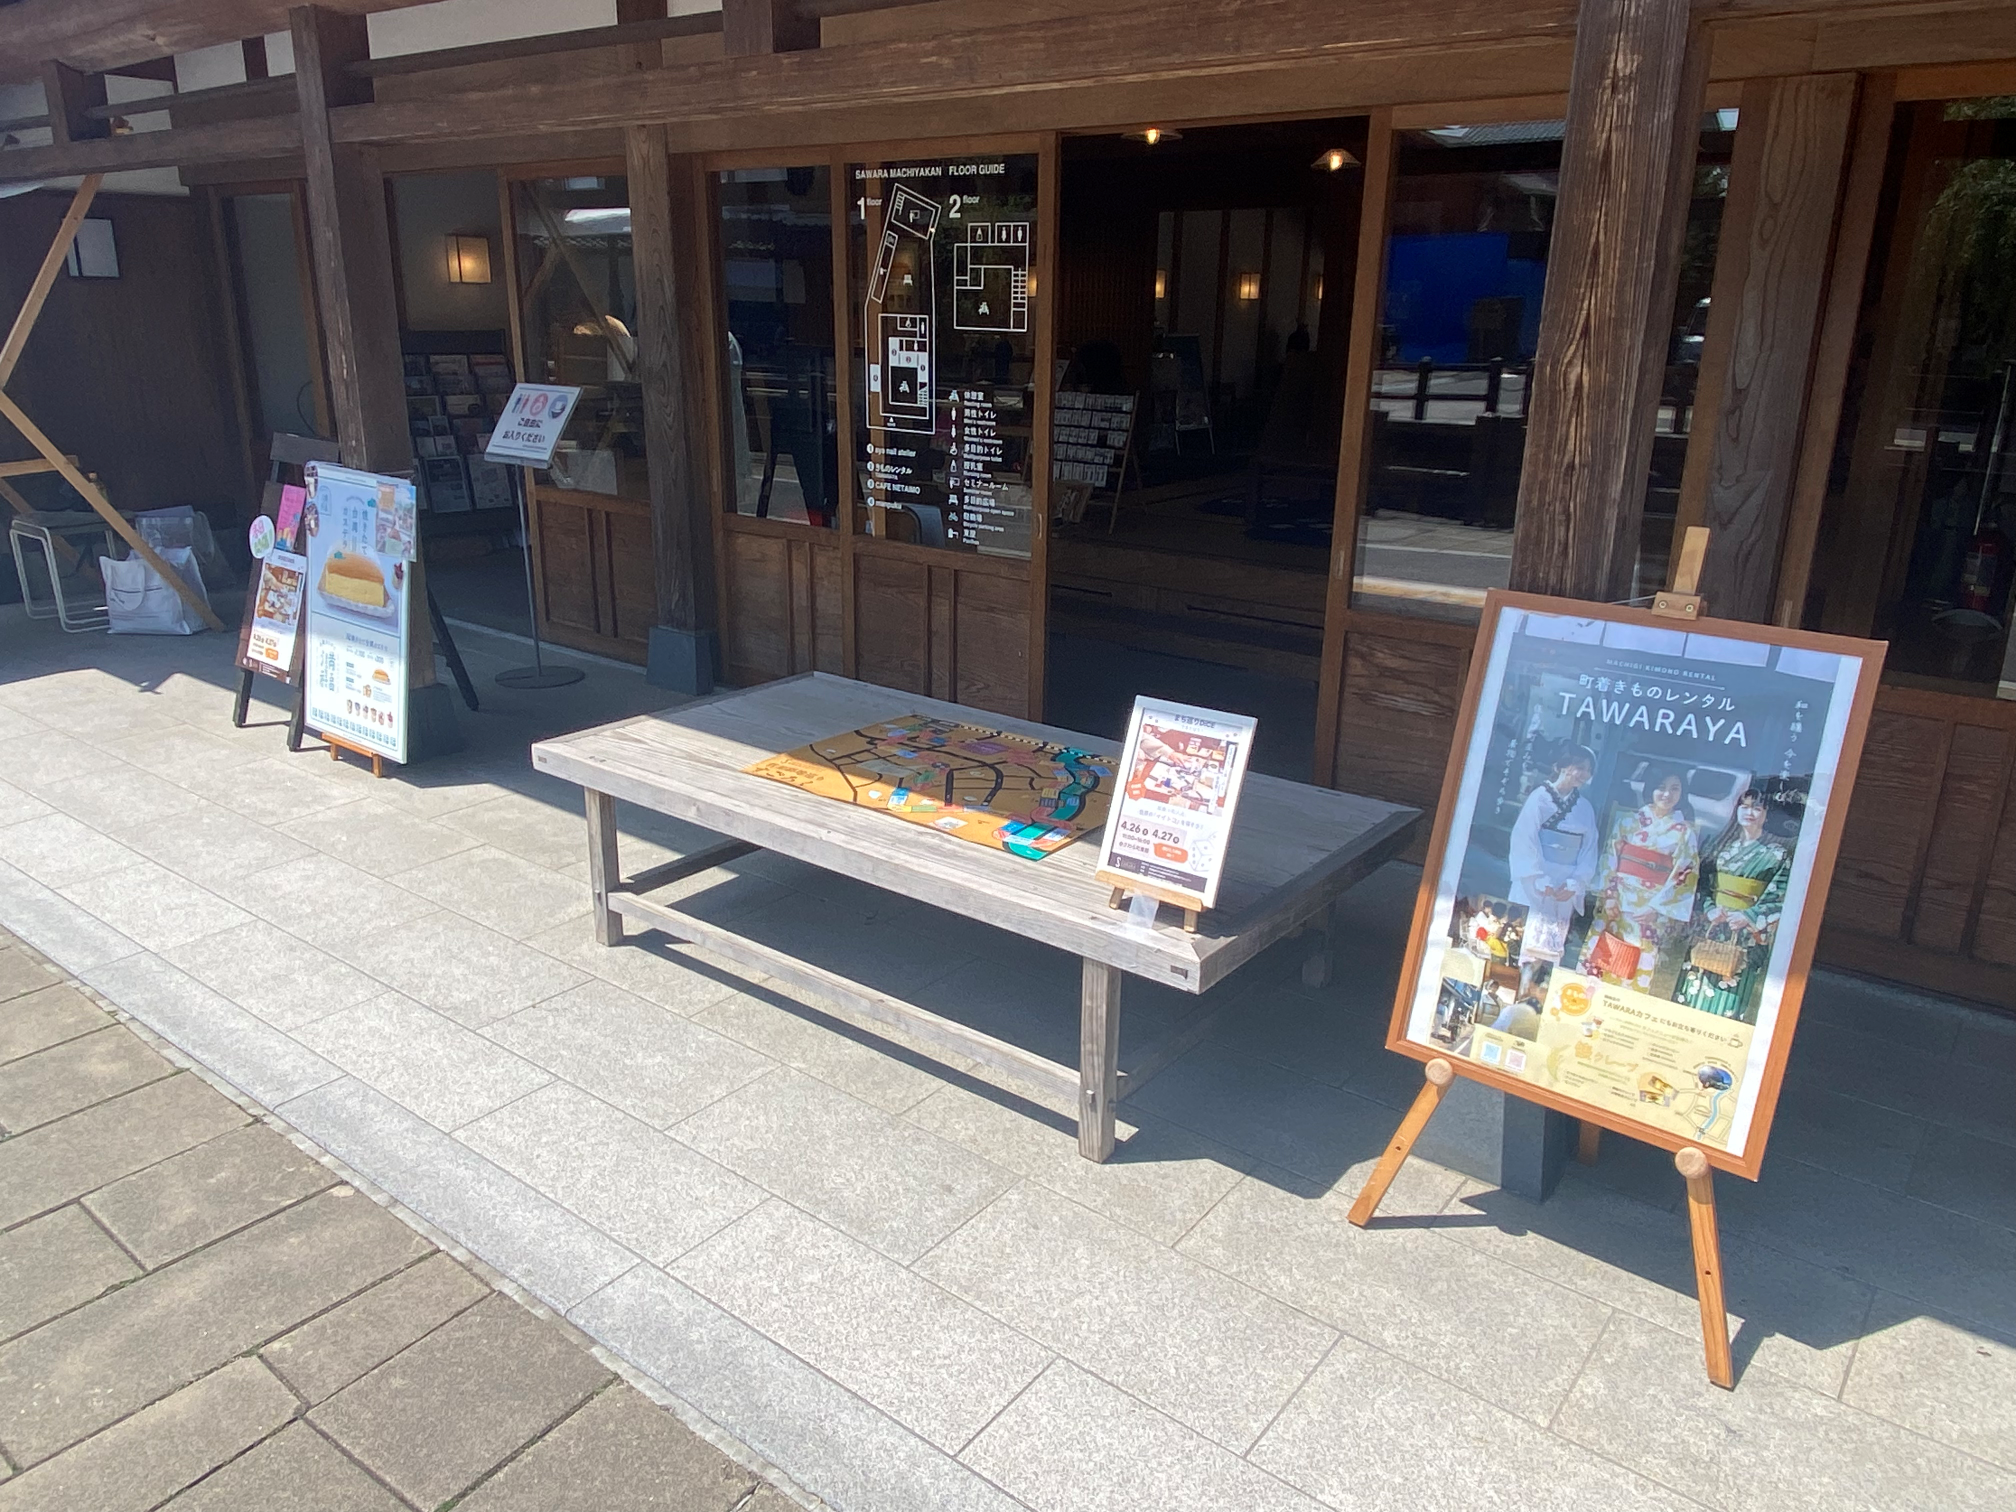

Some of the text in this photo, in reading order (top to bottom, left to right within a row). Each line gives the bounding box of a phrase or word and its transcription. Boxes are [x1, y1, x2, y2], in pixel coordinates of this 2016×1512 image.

[855, 163, 1005, 180] SAWARA MACHIYAKAN FLOOR GUIDE
[857, 197, 865, 219] 1
[949, 194, 980, 219] 2 floor
[502, 430, 546, 443] お入りください
[1606, 659, 1716, 681] MACHIGI KIMONO RENTAL
[1579, 674, 1735, 711] 町着きものレンタル
[1559, 692, 1747, 747] TAWARAYA
[1121, 821, 1173, 841] 4.26 4.27
